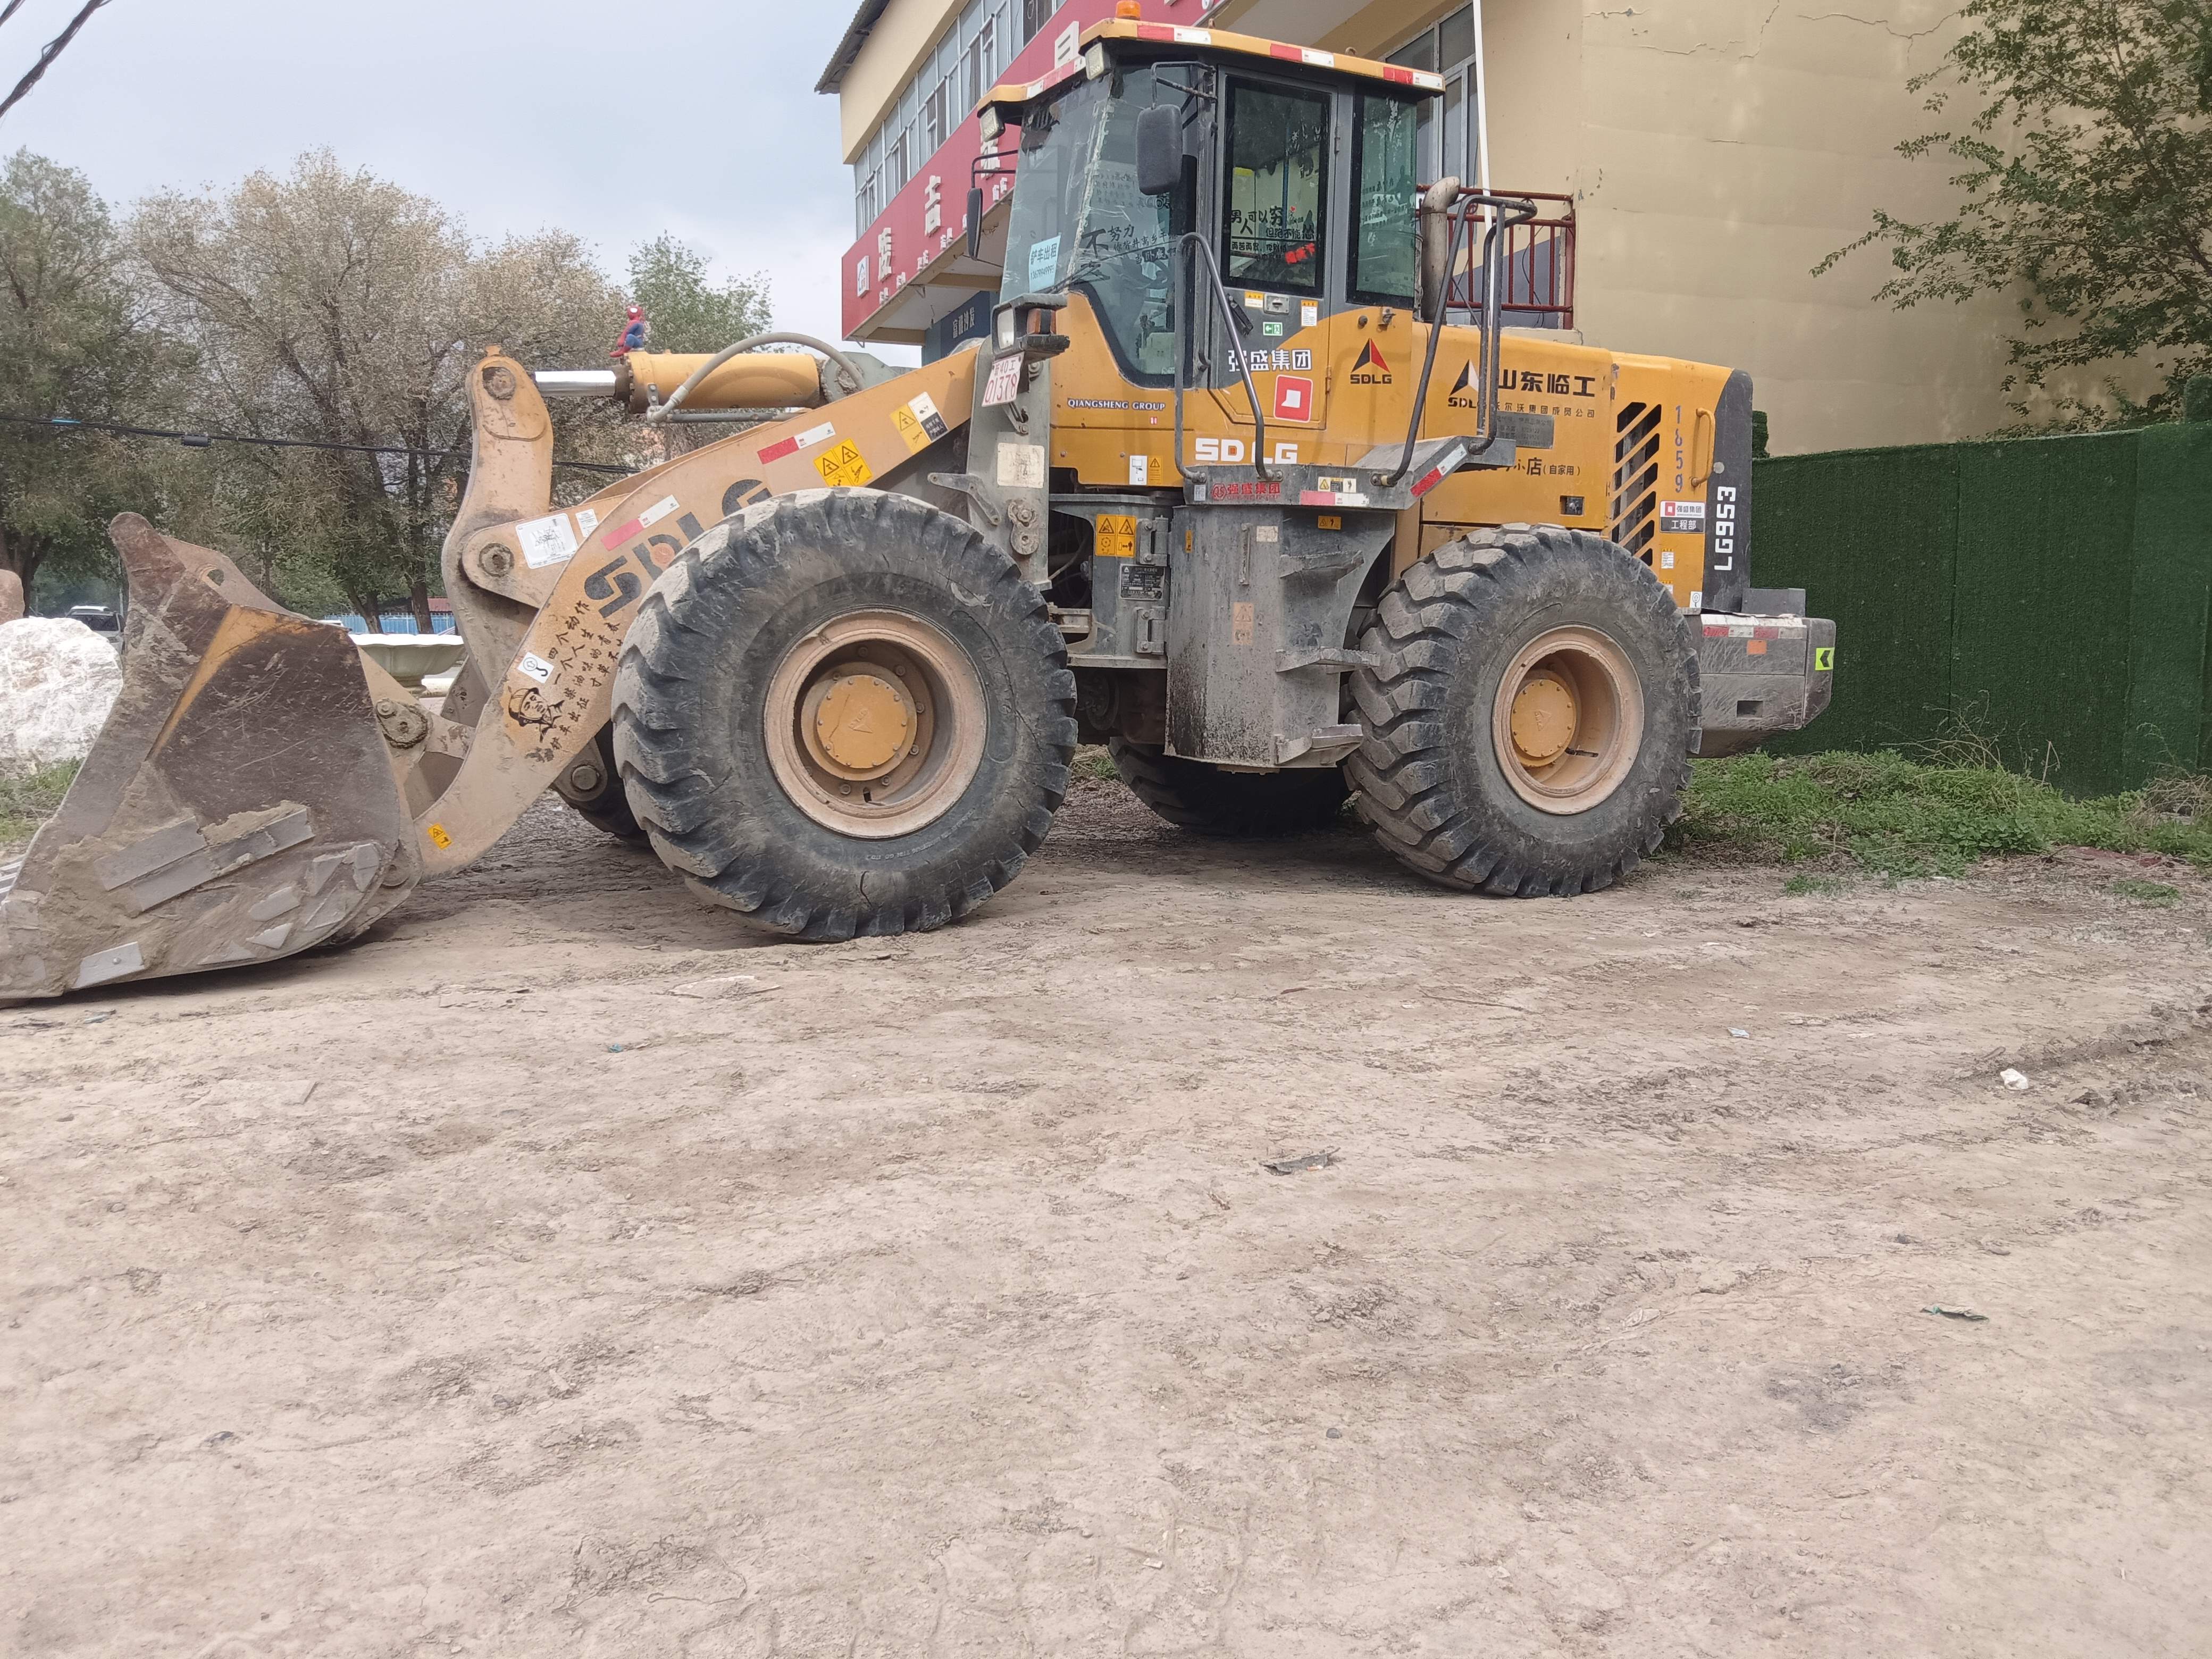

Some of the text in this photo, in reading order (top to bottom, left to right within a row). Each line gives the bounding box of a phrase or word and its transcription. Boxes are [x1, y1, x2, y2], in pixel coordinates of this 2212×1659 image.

[1350, 374, 1392, 384] SDLG
[1498, 369, 1595, 398] 山东临工
[1067, 398, 1166, 411] QIANGSHENG GROUP
[1448, 397, 1477, 408] SDL
[1195, 438, 1298, 464] SDLG
[1227, 482, 1280, 495] 强盛集团
[1671, 520, 1697, 530] 工程部
[1714, 486, 1736, 571] LG953
[548, 600, 591, 659] 四个动作
[564, 622, 621, 700] 柴油味的青春
